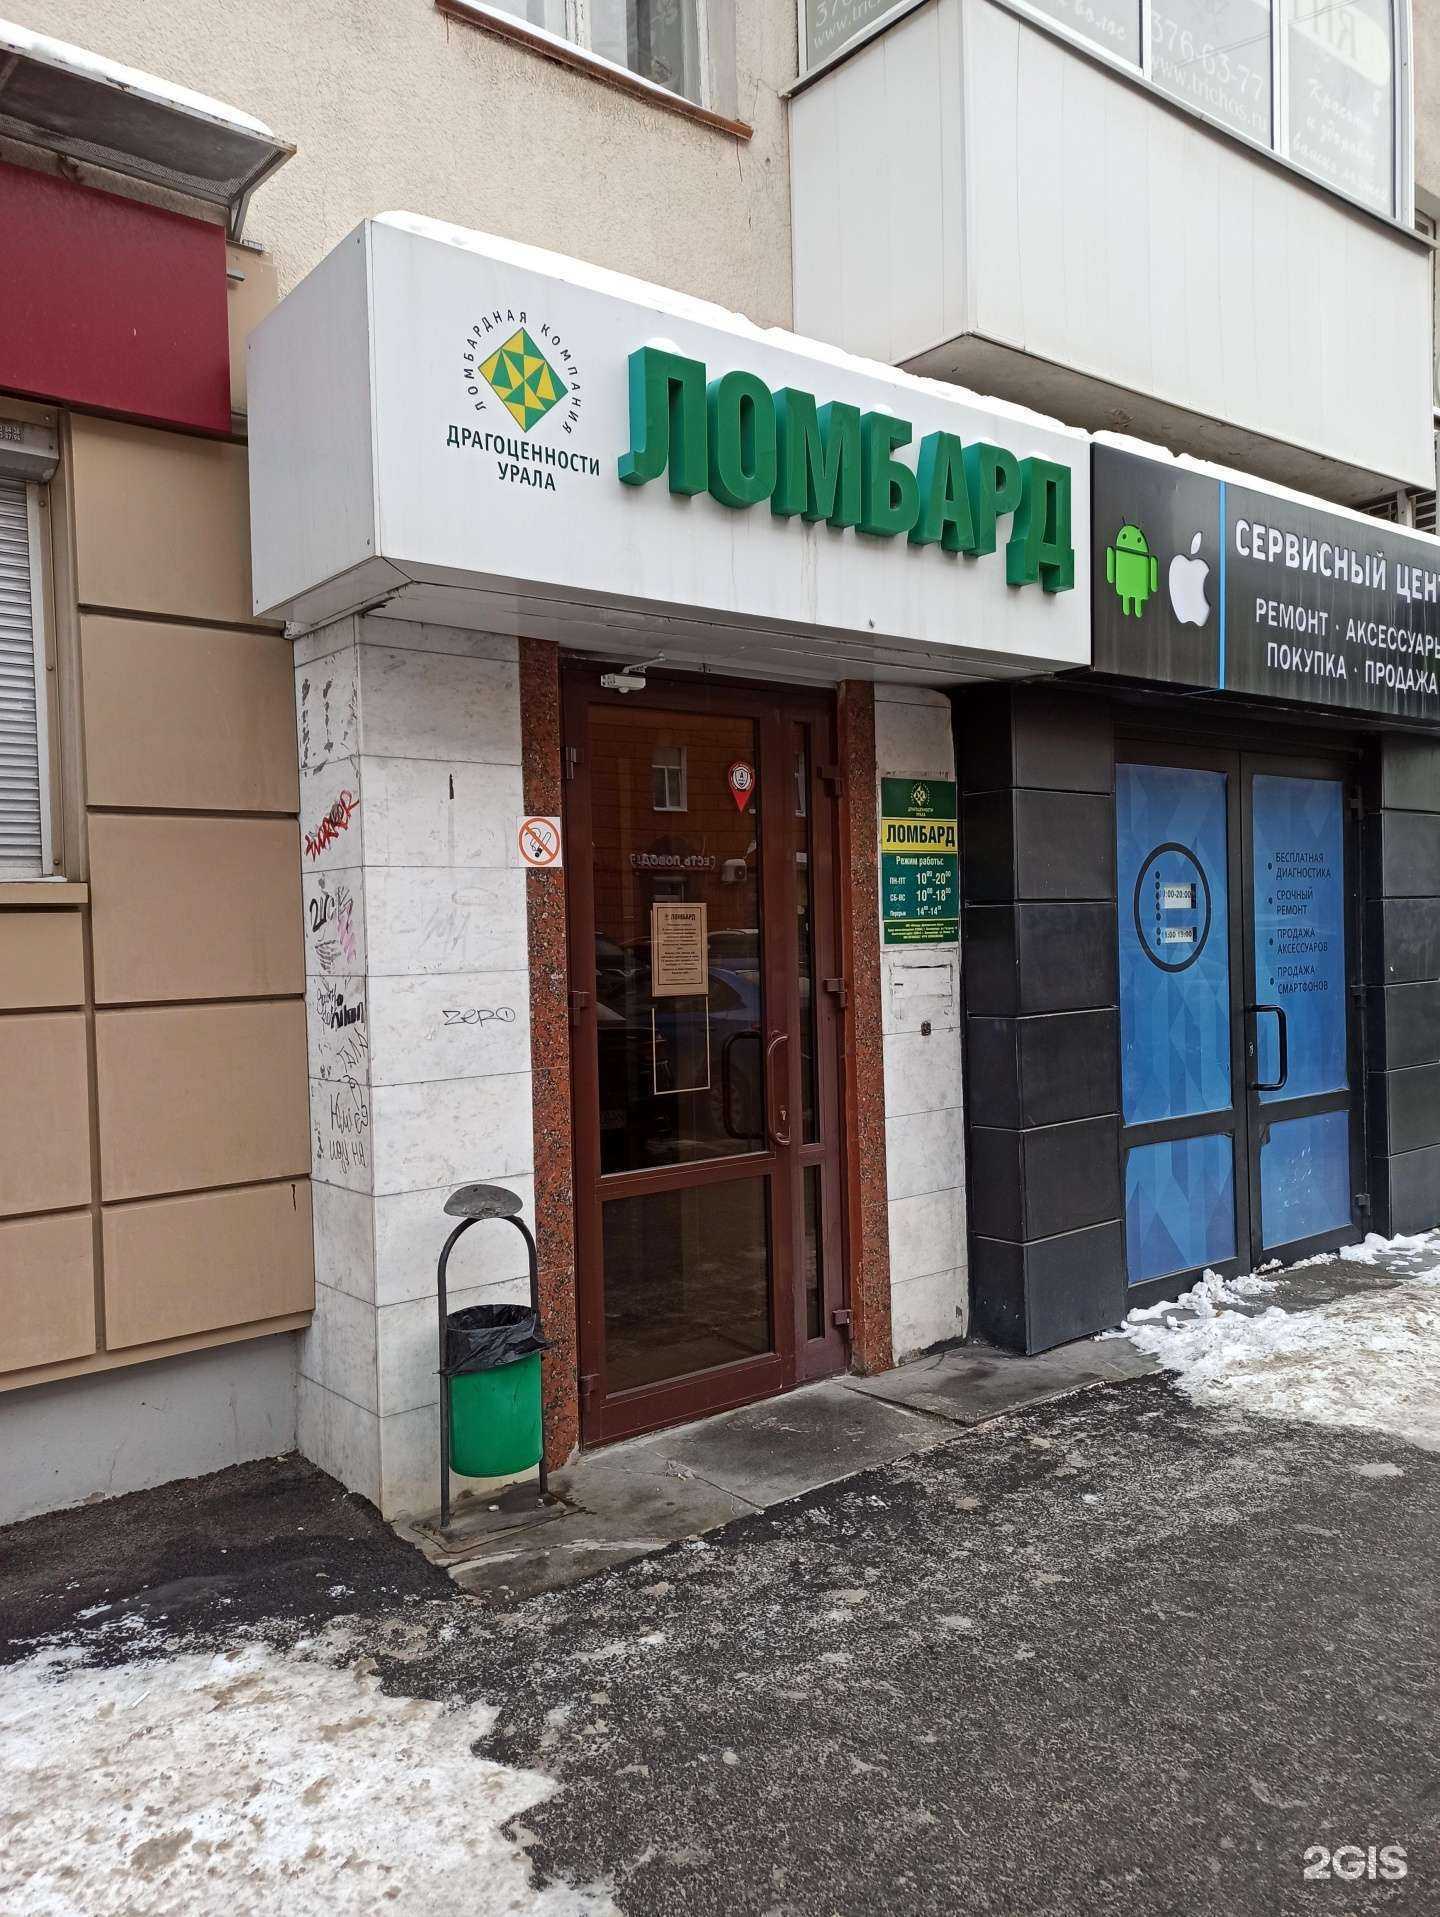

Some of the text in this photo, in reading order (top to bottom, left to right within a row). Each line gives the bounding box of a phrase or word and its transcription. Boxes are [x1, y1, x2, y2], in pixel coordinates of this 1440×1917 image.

[463, 309, 582, 434] ЛОМБАРДНАЯ КОМПАНИЯ
[446, 424, 600, 476] ДРАГОЦЕННОСТИ
[497, 461, 556, 492] УРАЛА
[617, 345, 1075, 594] ЛОМБАРД
[1235, 519, 1387, 591] СЕРВИСНЫЙ
[1256, 597, 1329, 636] РЕМОНТ
[1267, 642, 1438, 695] ПОКУПКА ПРОДАЖА
[886, 824, 956, 848] ЛОМБАРД
[895, 856, 918, 866] Режим
[1275, 852, 1324, 863] БЕСПЛАТНАЯ
[1275, 867, 1332, 880] ДИАГНОСТИКА
[1276, 886, 1313, 901] СРОЧНЫЙ
[1276, 904, 1308, 916] РЕМОНТ
[1277, 928, 1316, 941] ПРОДАЖА
[1277, 942, 1328, 955] АКСЕССУАРОВ
[1277, 965, 1316, 979] ПРОДАЖА
[1277, 981, 1329, 995] СМАРТФОНОВ
